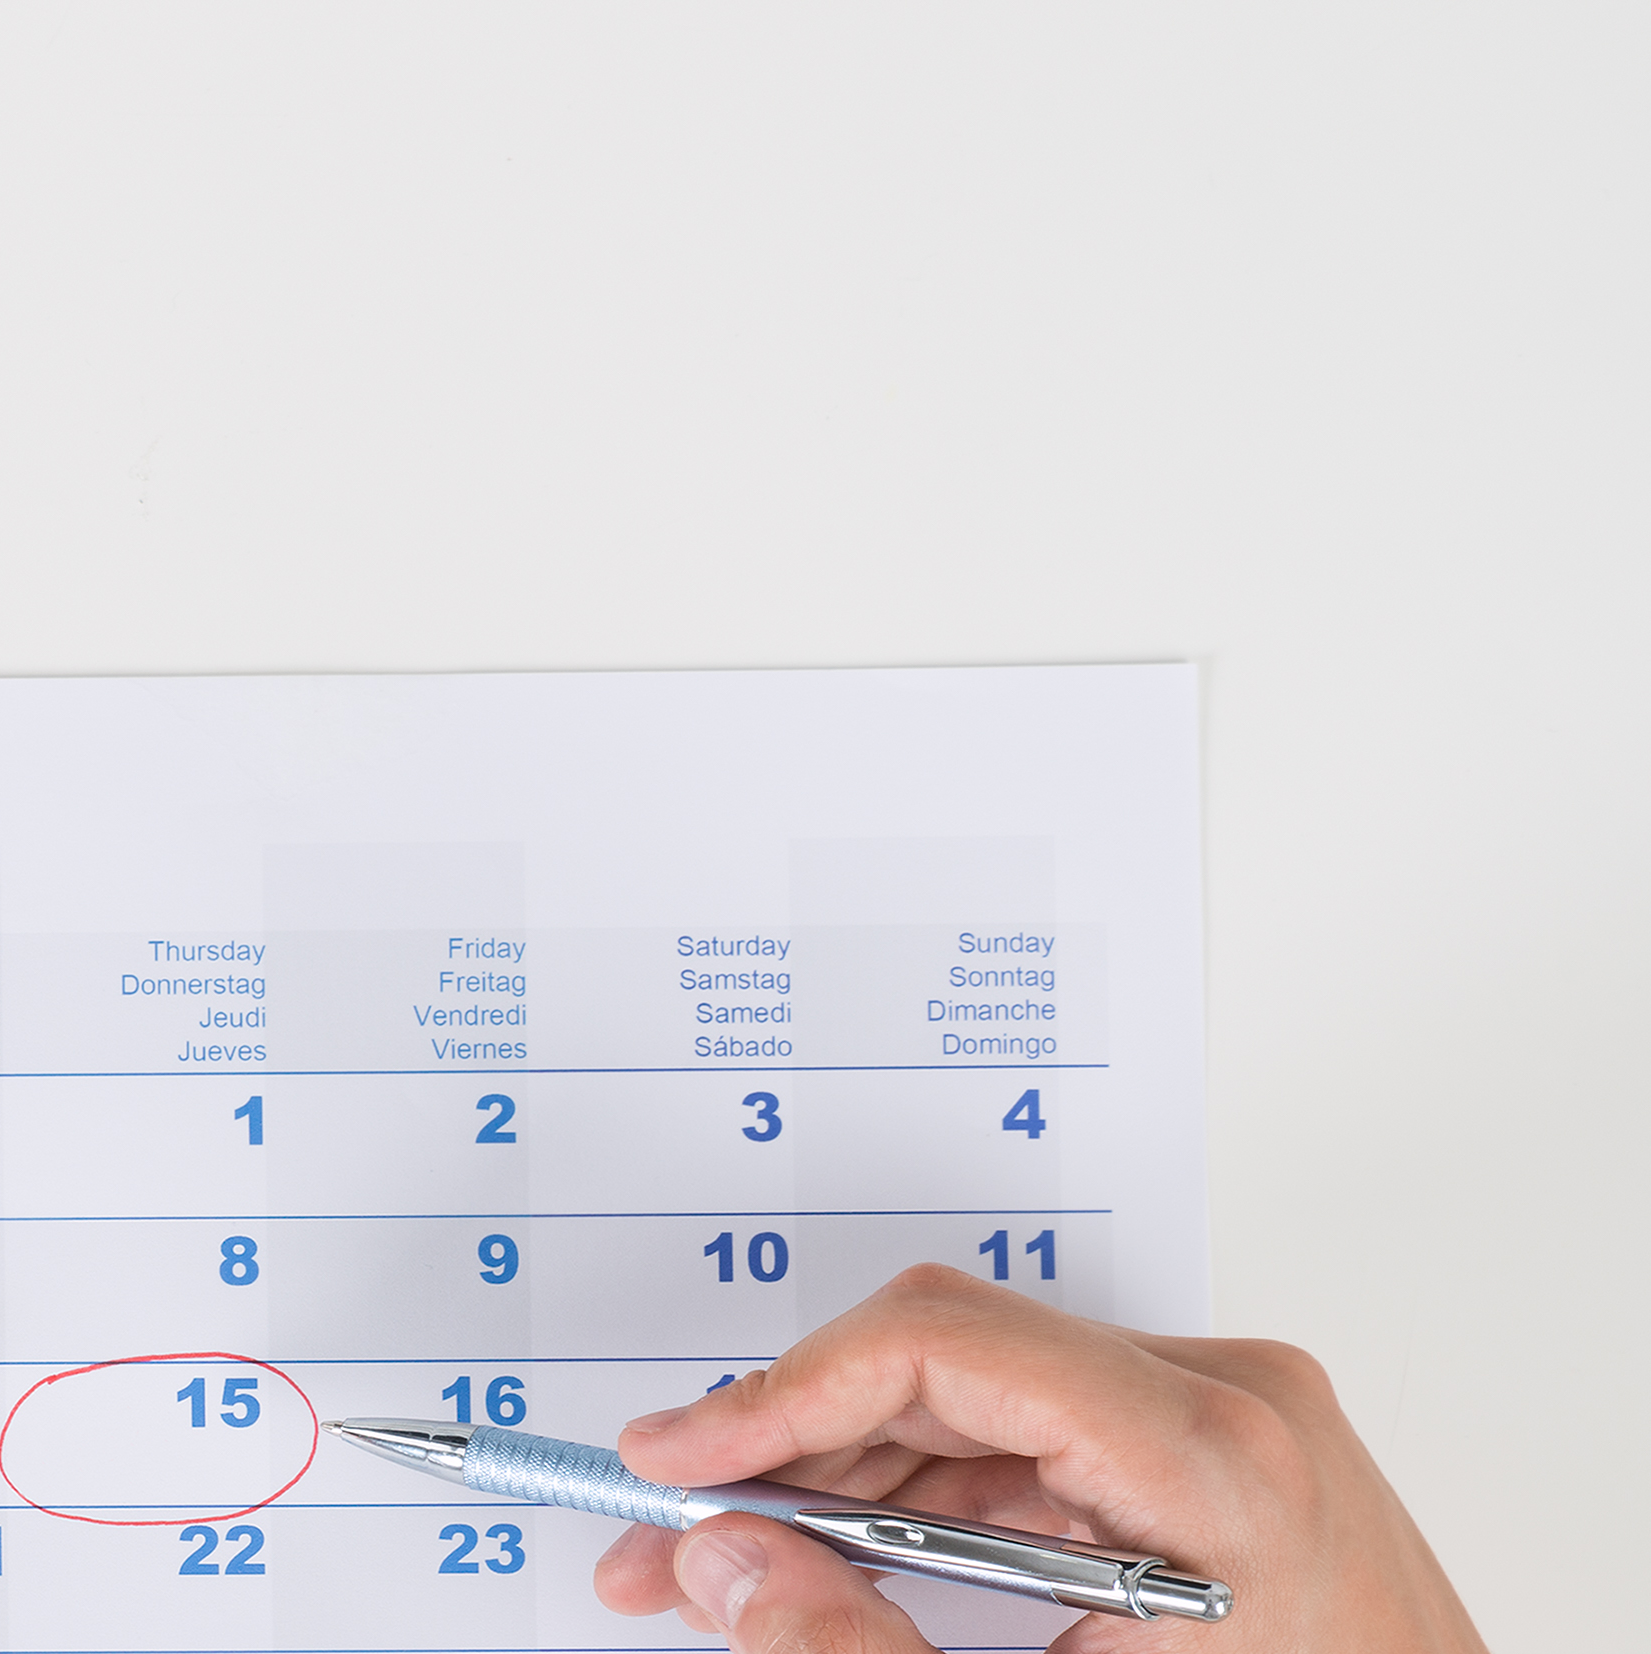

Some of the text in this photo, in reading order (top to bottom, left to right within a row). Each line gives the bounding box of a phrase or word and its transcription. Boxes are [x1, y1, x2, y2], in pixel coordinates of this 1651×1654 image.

[149, 941, 265, 965] Thursday
[449, 938, 526, 963] Friday
[678, 936, 790, 960] Saturday
[959, 933, 1054, 957] Sunday
[122, 975, 265, 999] Donnerstag
[440, 972, 525, 997] Freitag
[681, 970, 790, 994] Samstag
[950, 967, 1054, 991] Sonntag
[200, 1007, 265, 1028] Jeudi
[414, 1005, 526, 1026] Vendredi
[697, 1003, 791, 1023] Samedi
[928, 1000, 1055, 1021] Dimanche
[178, 1042, 266, 1061] Jueves
[432, 1039, 527, 1059] Viernes
[695, 1036, 792, 1057] Sábado
[944, 1034, 1056, 1059] Domingo
[235, 1096, 263, 1145] 1
[476, 1094, 516, 1143] 2
[742, 1092, 782, 1142] 3
[1003, 1089, 1046, 1139] 4
[219, 1236, 259, 1286] 8
[478, 1234, 519, 1284] 9
[704, 1232, 788, 1282] 10
[980, 1230, 1055, 1280] 11
[177, 1378, 260, 1428] 15
[442, 1376, 526, 1425] 16
[179, 1525, 265, 1575] 22
[438, 1524, 525, 1574] 23
